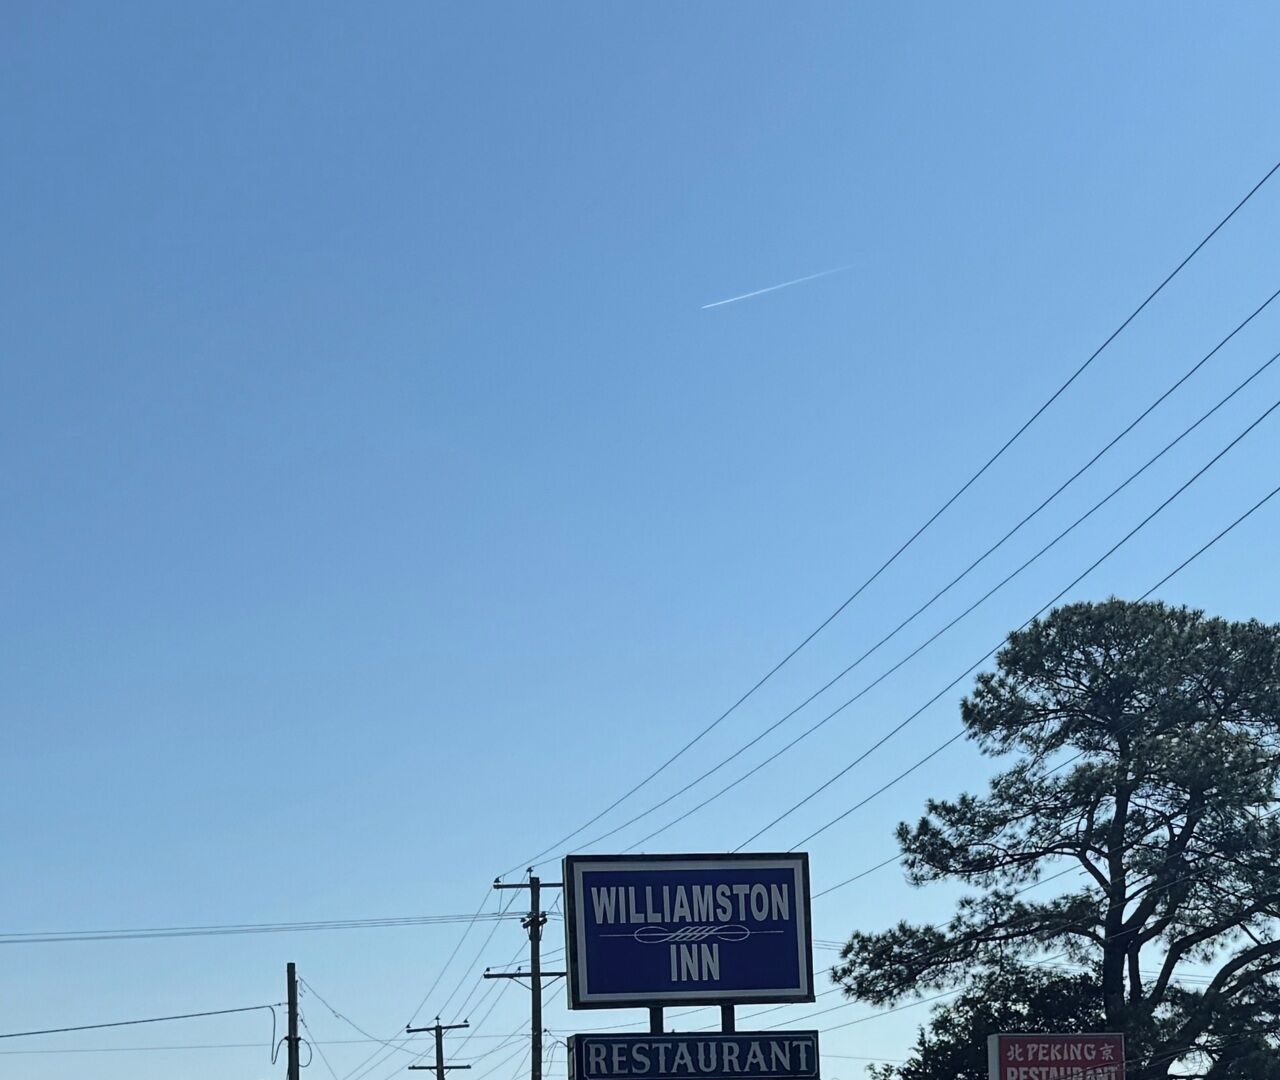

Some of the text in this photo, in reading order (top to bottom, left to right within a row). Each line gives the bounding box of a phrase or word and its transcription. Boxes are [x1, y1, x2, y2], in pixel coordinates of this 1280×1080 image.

[591, 883, 789, 924] WILLIAMSTON
[670, 943, 720, 982] INN
[588, 1040, 812, 1074] RESTAURANT
[1007, 1043, 1114, 1061] 北 PEKING 京
